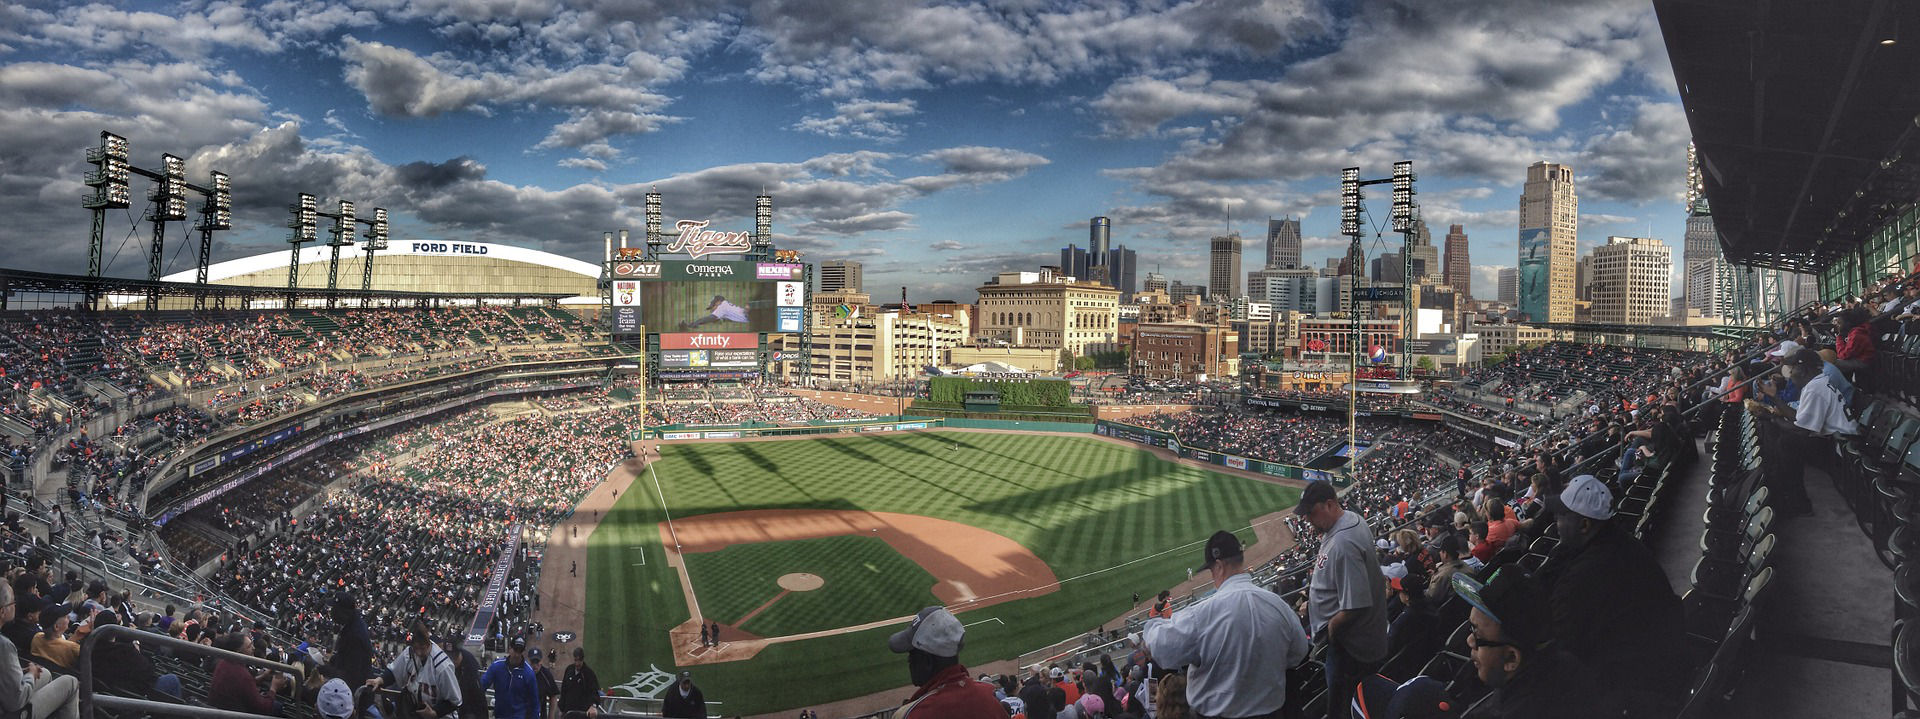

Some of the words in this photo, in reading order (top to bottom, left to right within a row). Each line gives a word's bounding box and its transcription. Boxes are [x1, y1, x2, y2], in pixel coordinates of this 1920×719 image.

[667, 220, 751, 258] Tigers
[412, 243, 448, 252] FORD
[452, 244, 488, 254] FIELD
[633, 264, 660, 274] ATI
[1370, 288, 1404, 298] MICHIGAN
[690, 334, 730, 347] xfinity
[1228, 459, 1244, 467] meijer
[1264, 464, 1285, 472] EASTERN
[194, 489, 216, 506] DETROIT
[222, 480, 238, 492] TEXAS
[492, 565, 507, 586] DETROIT
[484, 588, 500, 608] TIGERS
